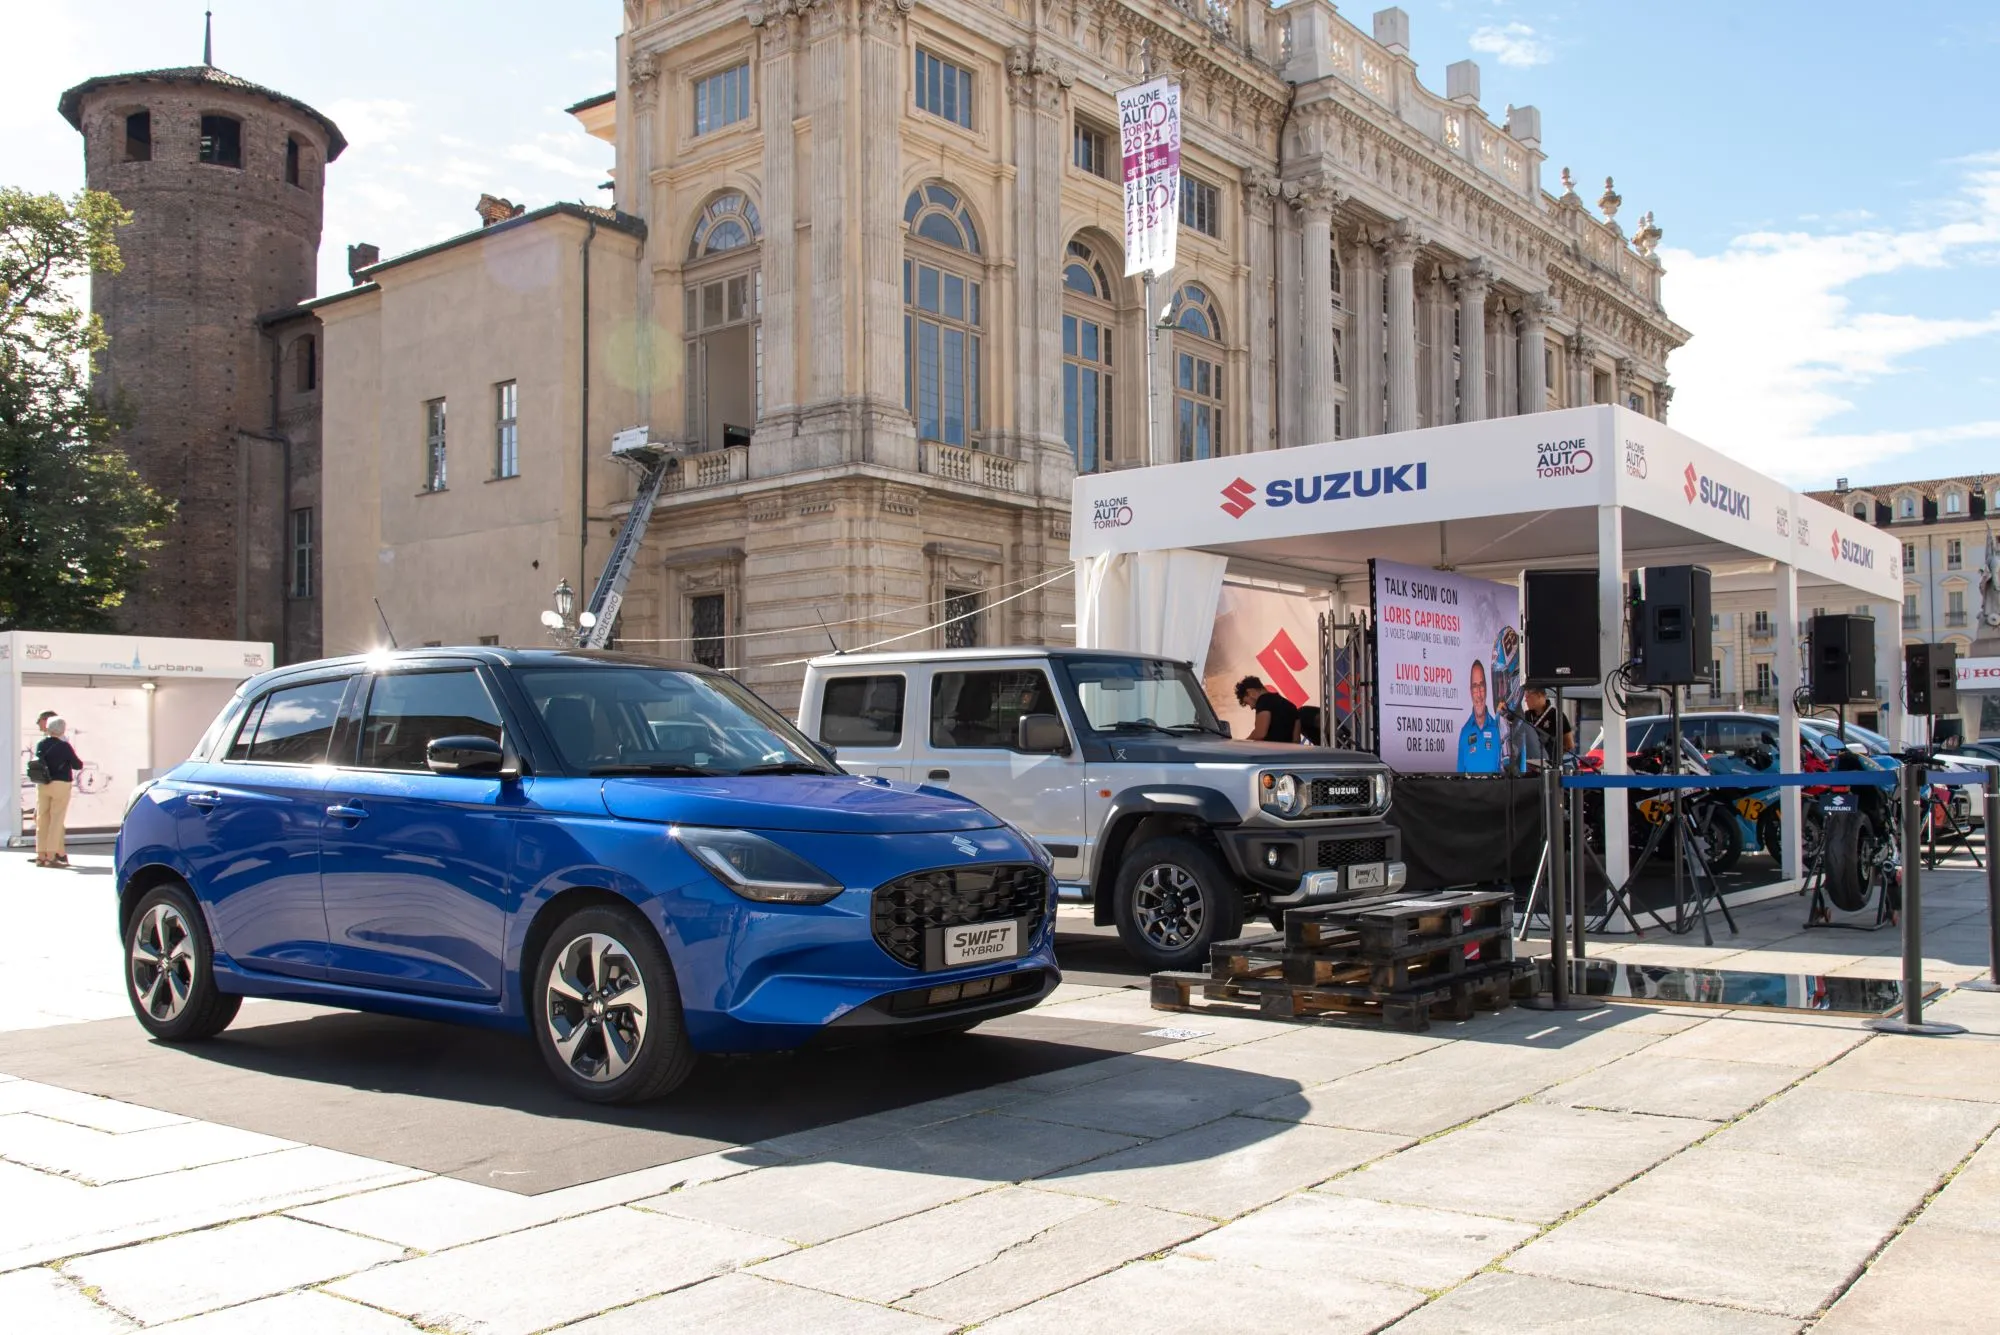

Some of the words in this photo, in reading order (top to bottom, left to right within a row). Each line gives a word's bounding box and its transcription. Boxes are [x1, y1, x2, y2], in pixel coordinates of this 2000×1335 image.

[1120, 89, 1160, 112] SALONE
[1123, 101, 1167, 127] AUTO
[1124, 129, 1161, 154] 2024
[1537, 438, 1586, 454] SALONE
[1625, 439, 1645, 456] SALONE
[1537, 450, 1594, 473] AUTO
[1265, 461, 1427, 508] SUZUKI
[1094, 496, 1128, 509] SALONE
[1699, 475, 1750, 521] SUZUKI
[1093, 506, 1133, 525] AUTO
[1841, 538, 1874, 570] SUZUKI
[1384, 577, 1408, 597] TALK
[1411, 582, 1438, 602] SHOW
[1440, 587, 1458, 606] CON
[1383, 605, 1411, 625] LORIS
[1414, 609, 1460, 632] CAPIROSSI
[1422, 647, 1427, 659] E
[147, 663, 205, 673] urbana
[1396, 663, 1420, 682] LIVIO
[1423, 665, 1452, 684] SUPPO
[1396, 716, 1423, 732] STAND
[1425, 718, 1454, 733] SUZUKI
[1406, 737, 1422, 752] ORE
[1425, 737, 1445, 753] 16:00
[1328, 786, 1359, 796] SUZUKI
[953, 927, 1011, 948] SWIFT
[961, 943, 1004, 957] HYBRID
